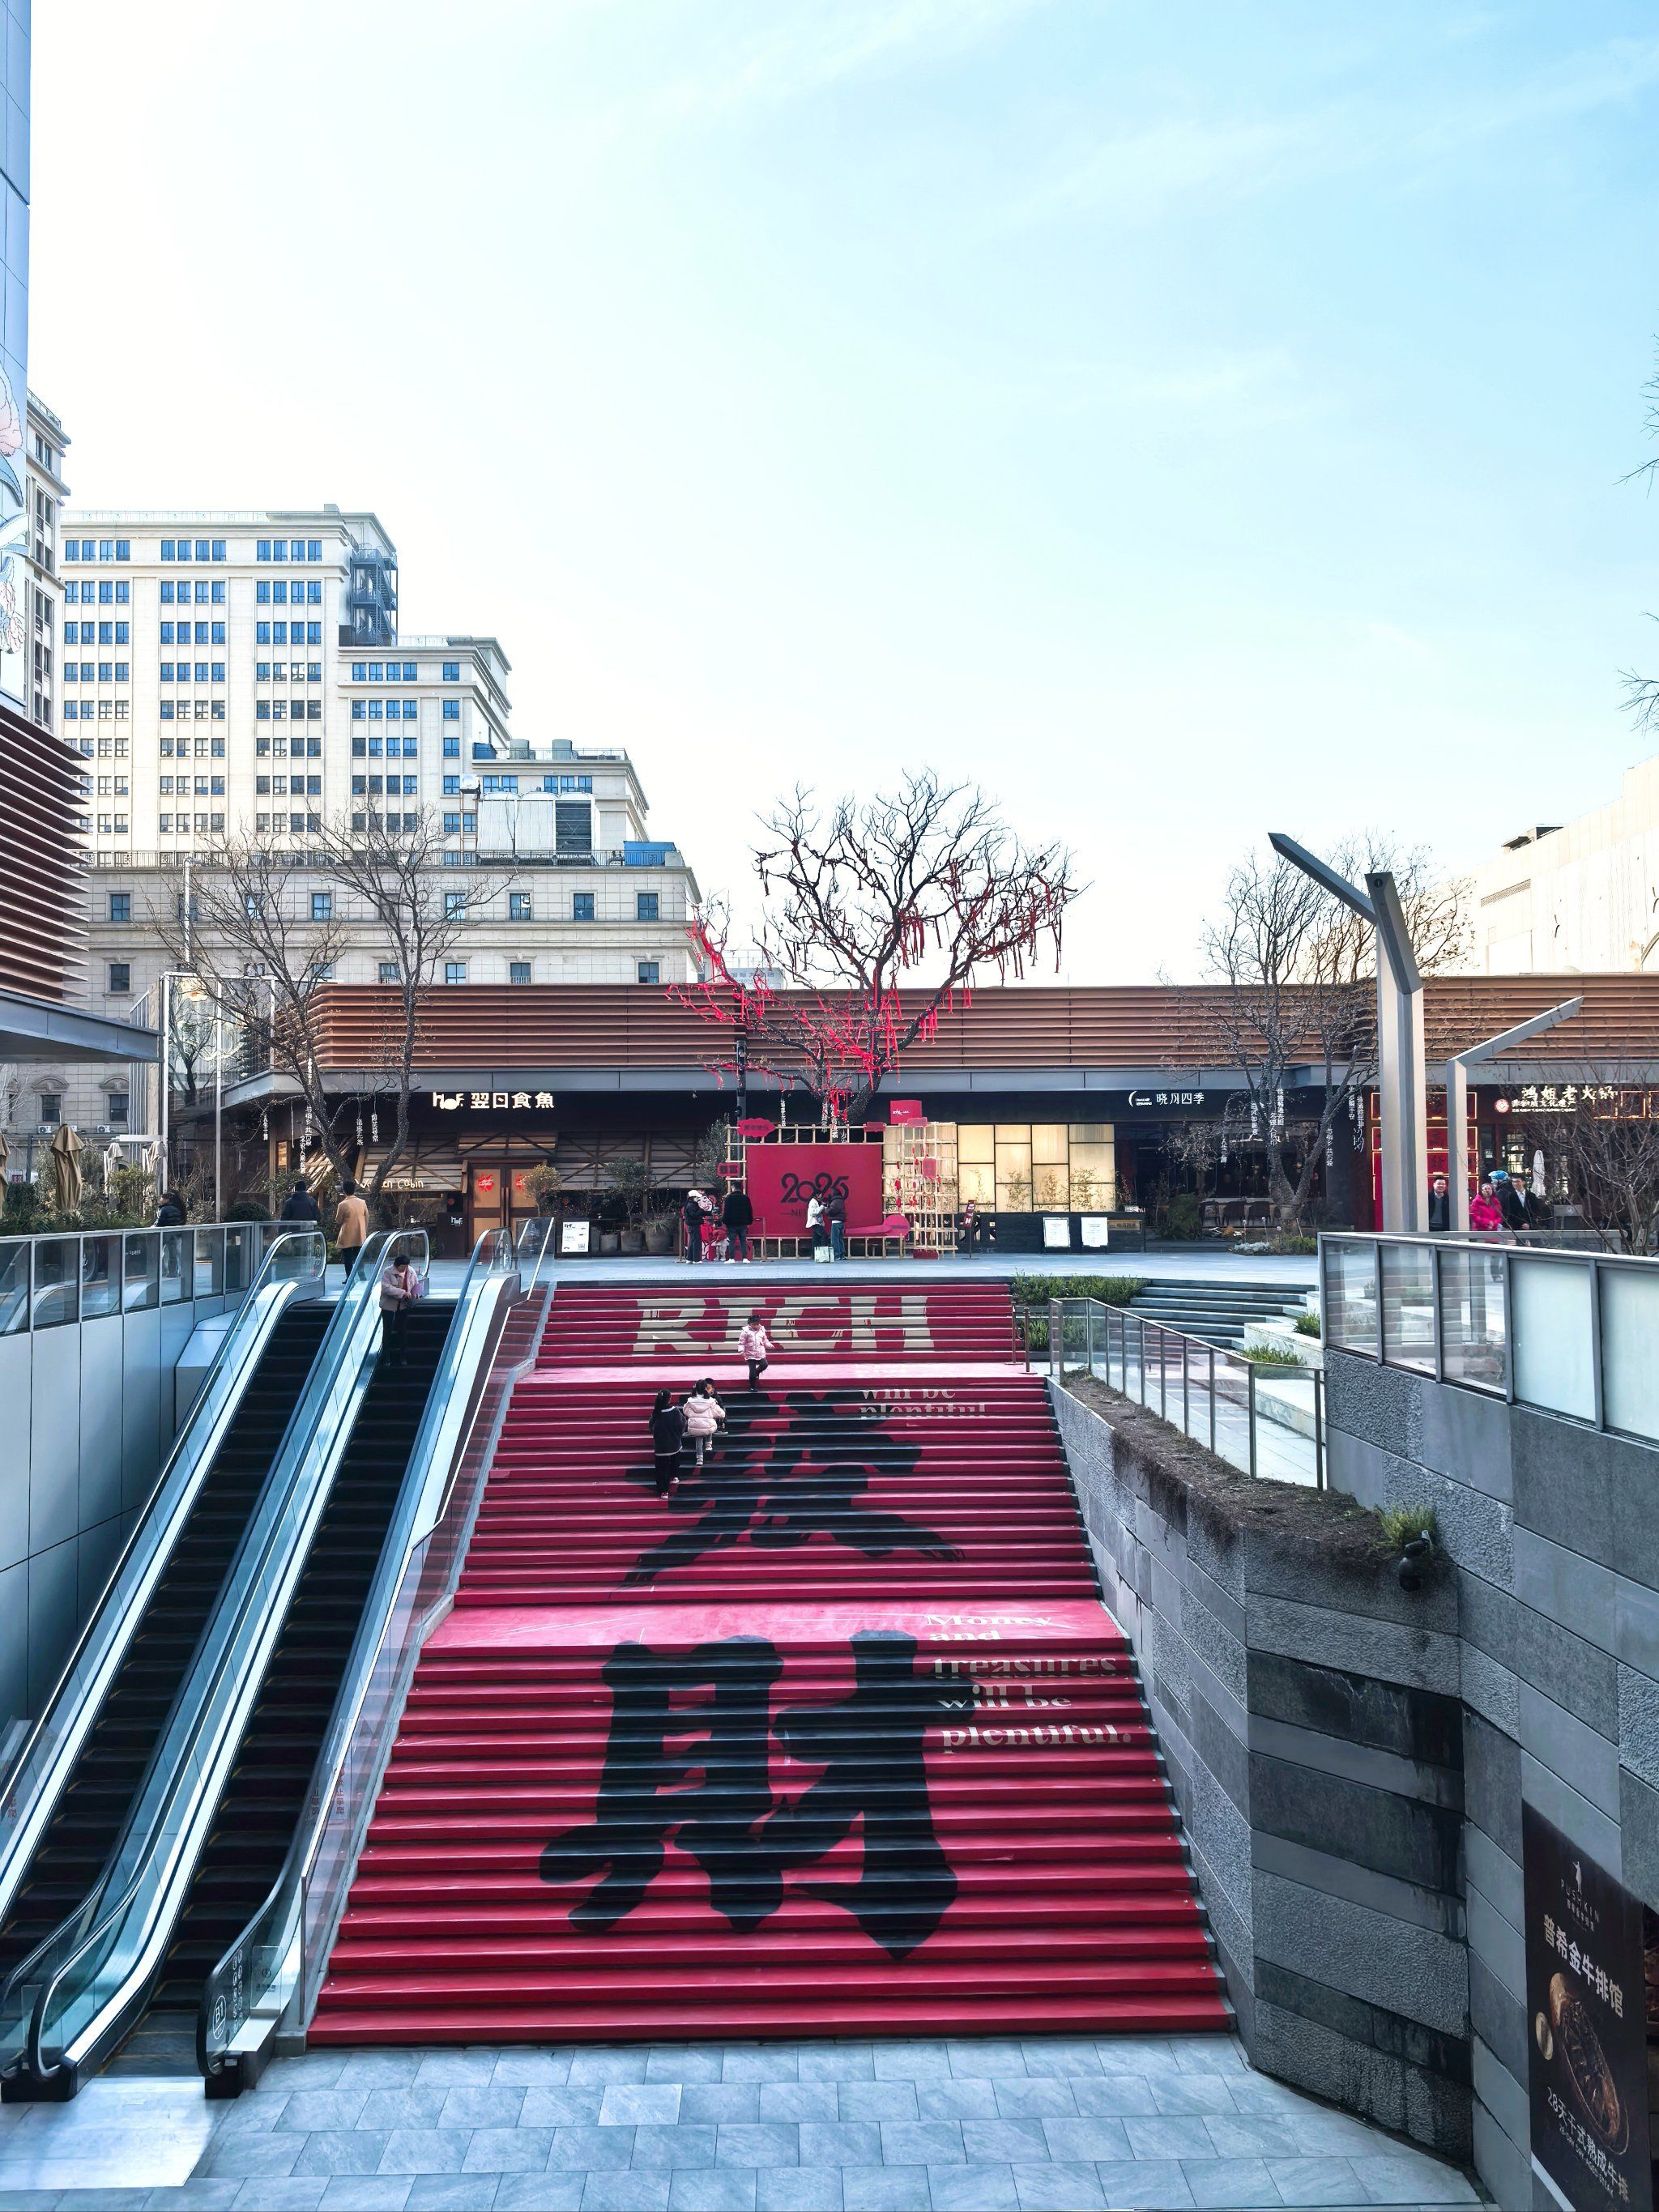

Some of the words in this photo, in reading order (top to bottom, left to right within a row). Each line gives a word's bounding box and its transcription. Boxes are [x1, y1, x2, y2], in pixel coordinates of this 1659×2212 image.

[1156, 1093, 1205, 1105] 晓月四季
[633, 1296, 935, 1352] RICH
[924, 1614, 1052, 1626] Money
[929, 1630, 1003, 1641] and
[934, 1657, 1116, 1678] treasures
[937, 1685, 1012, 1708] will
[1025, 1685, 1072, 1708] be
[940, 1724, 1132, 1754] plentiful.
[1543, 1913, 1623, 2018] 普希金牛排馆
